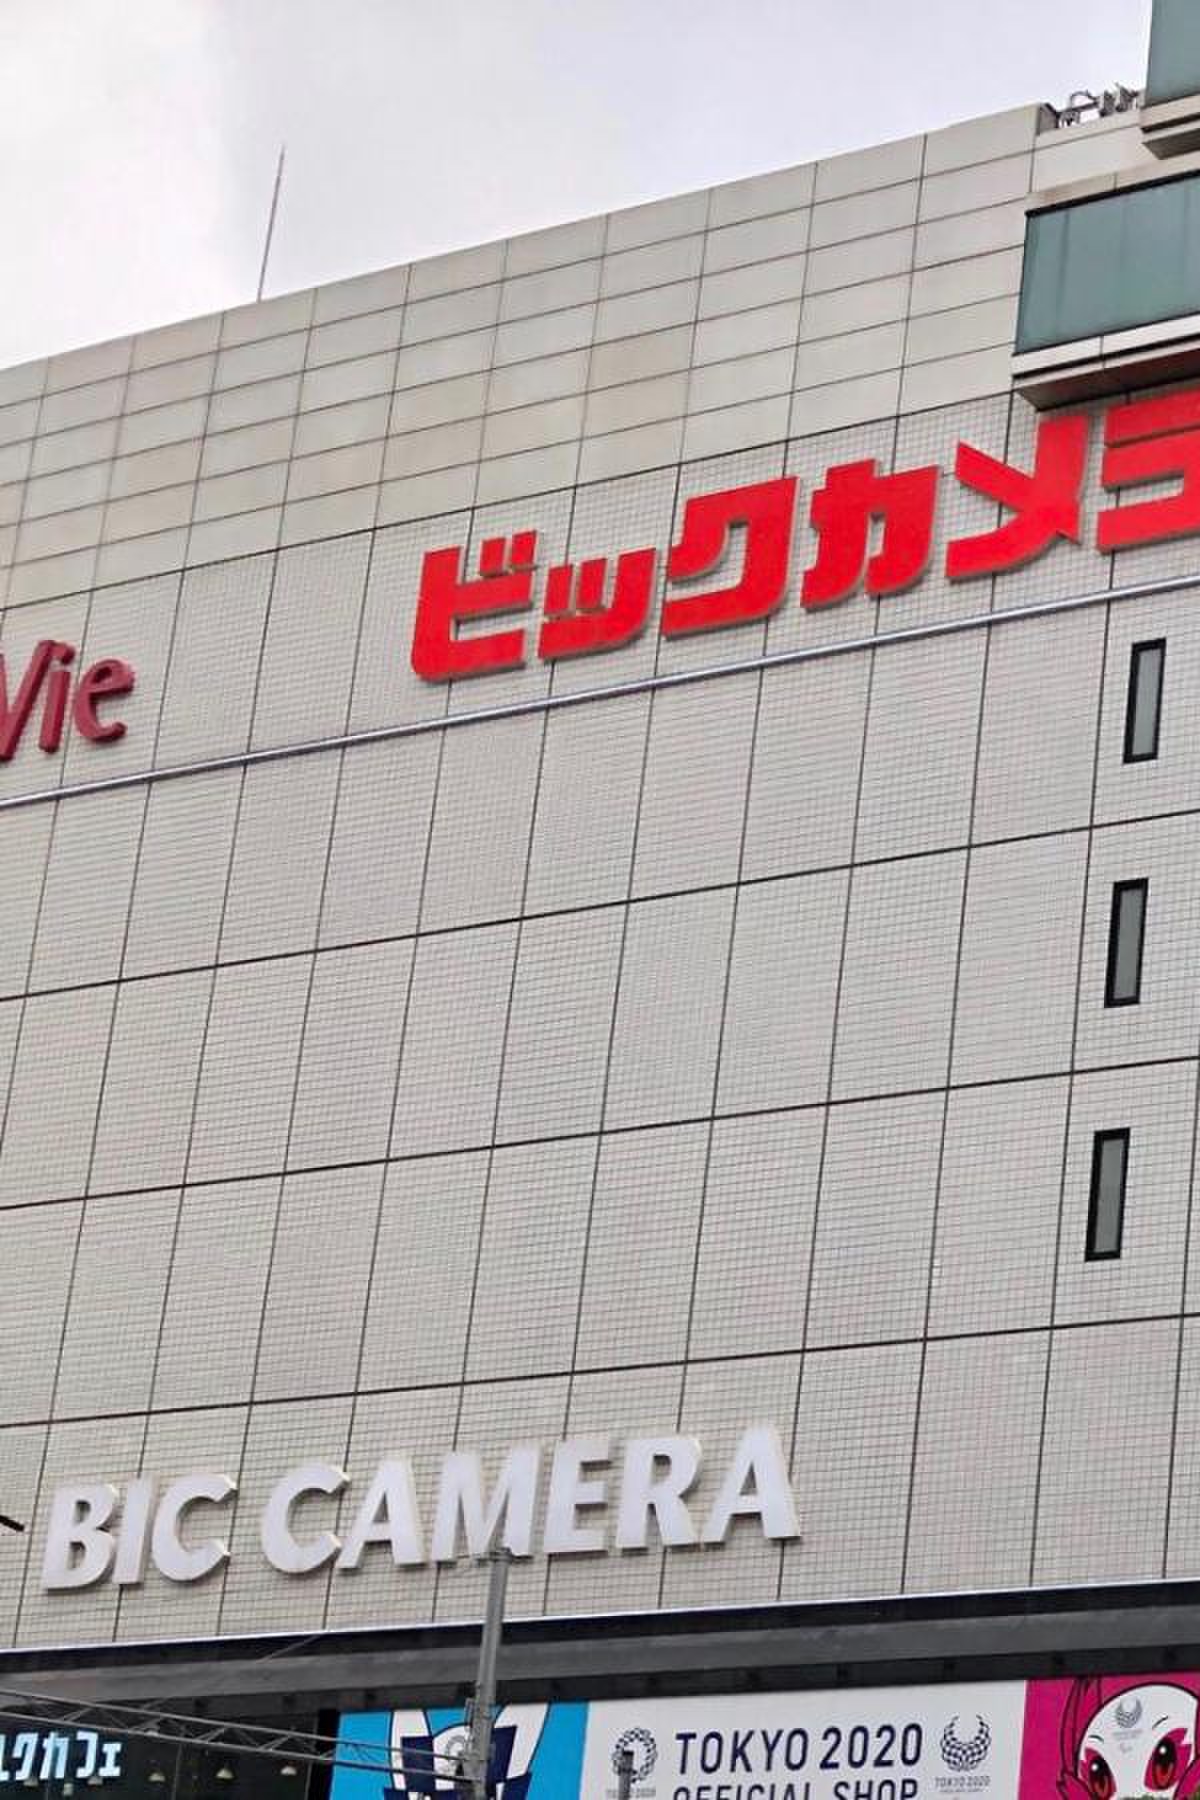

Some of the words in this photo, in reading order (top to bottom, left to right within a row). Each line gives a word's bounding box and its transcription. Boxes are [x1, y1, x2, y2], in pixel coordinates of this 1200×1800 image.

[42, 1472, 239, 1592] BIC
[261, 1424, 801, 1575] CAMERA
[675, 1728, 809, 1775] TOKYO
[819, 1723, 923, 1770] 2020
